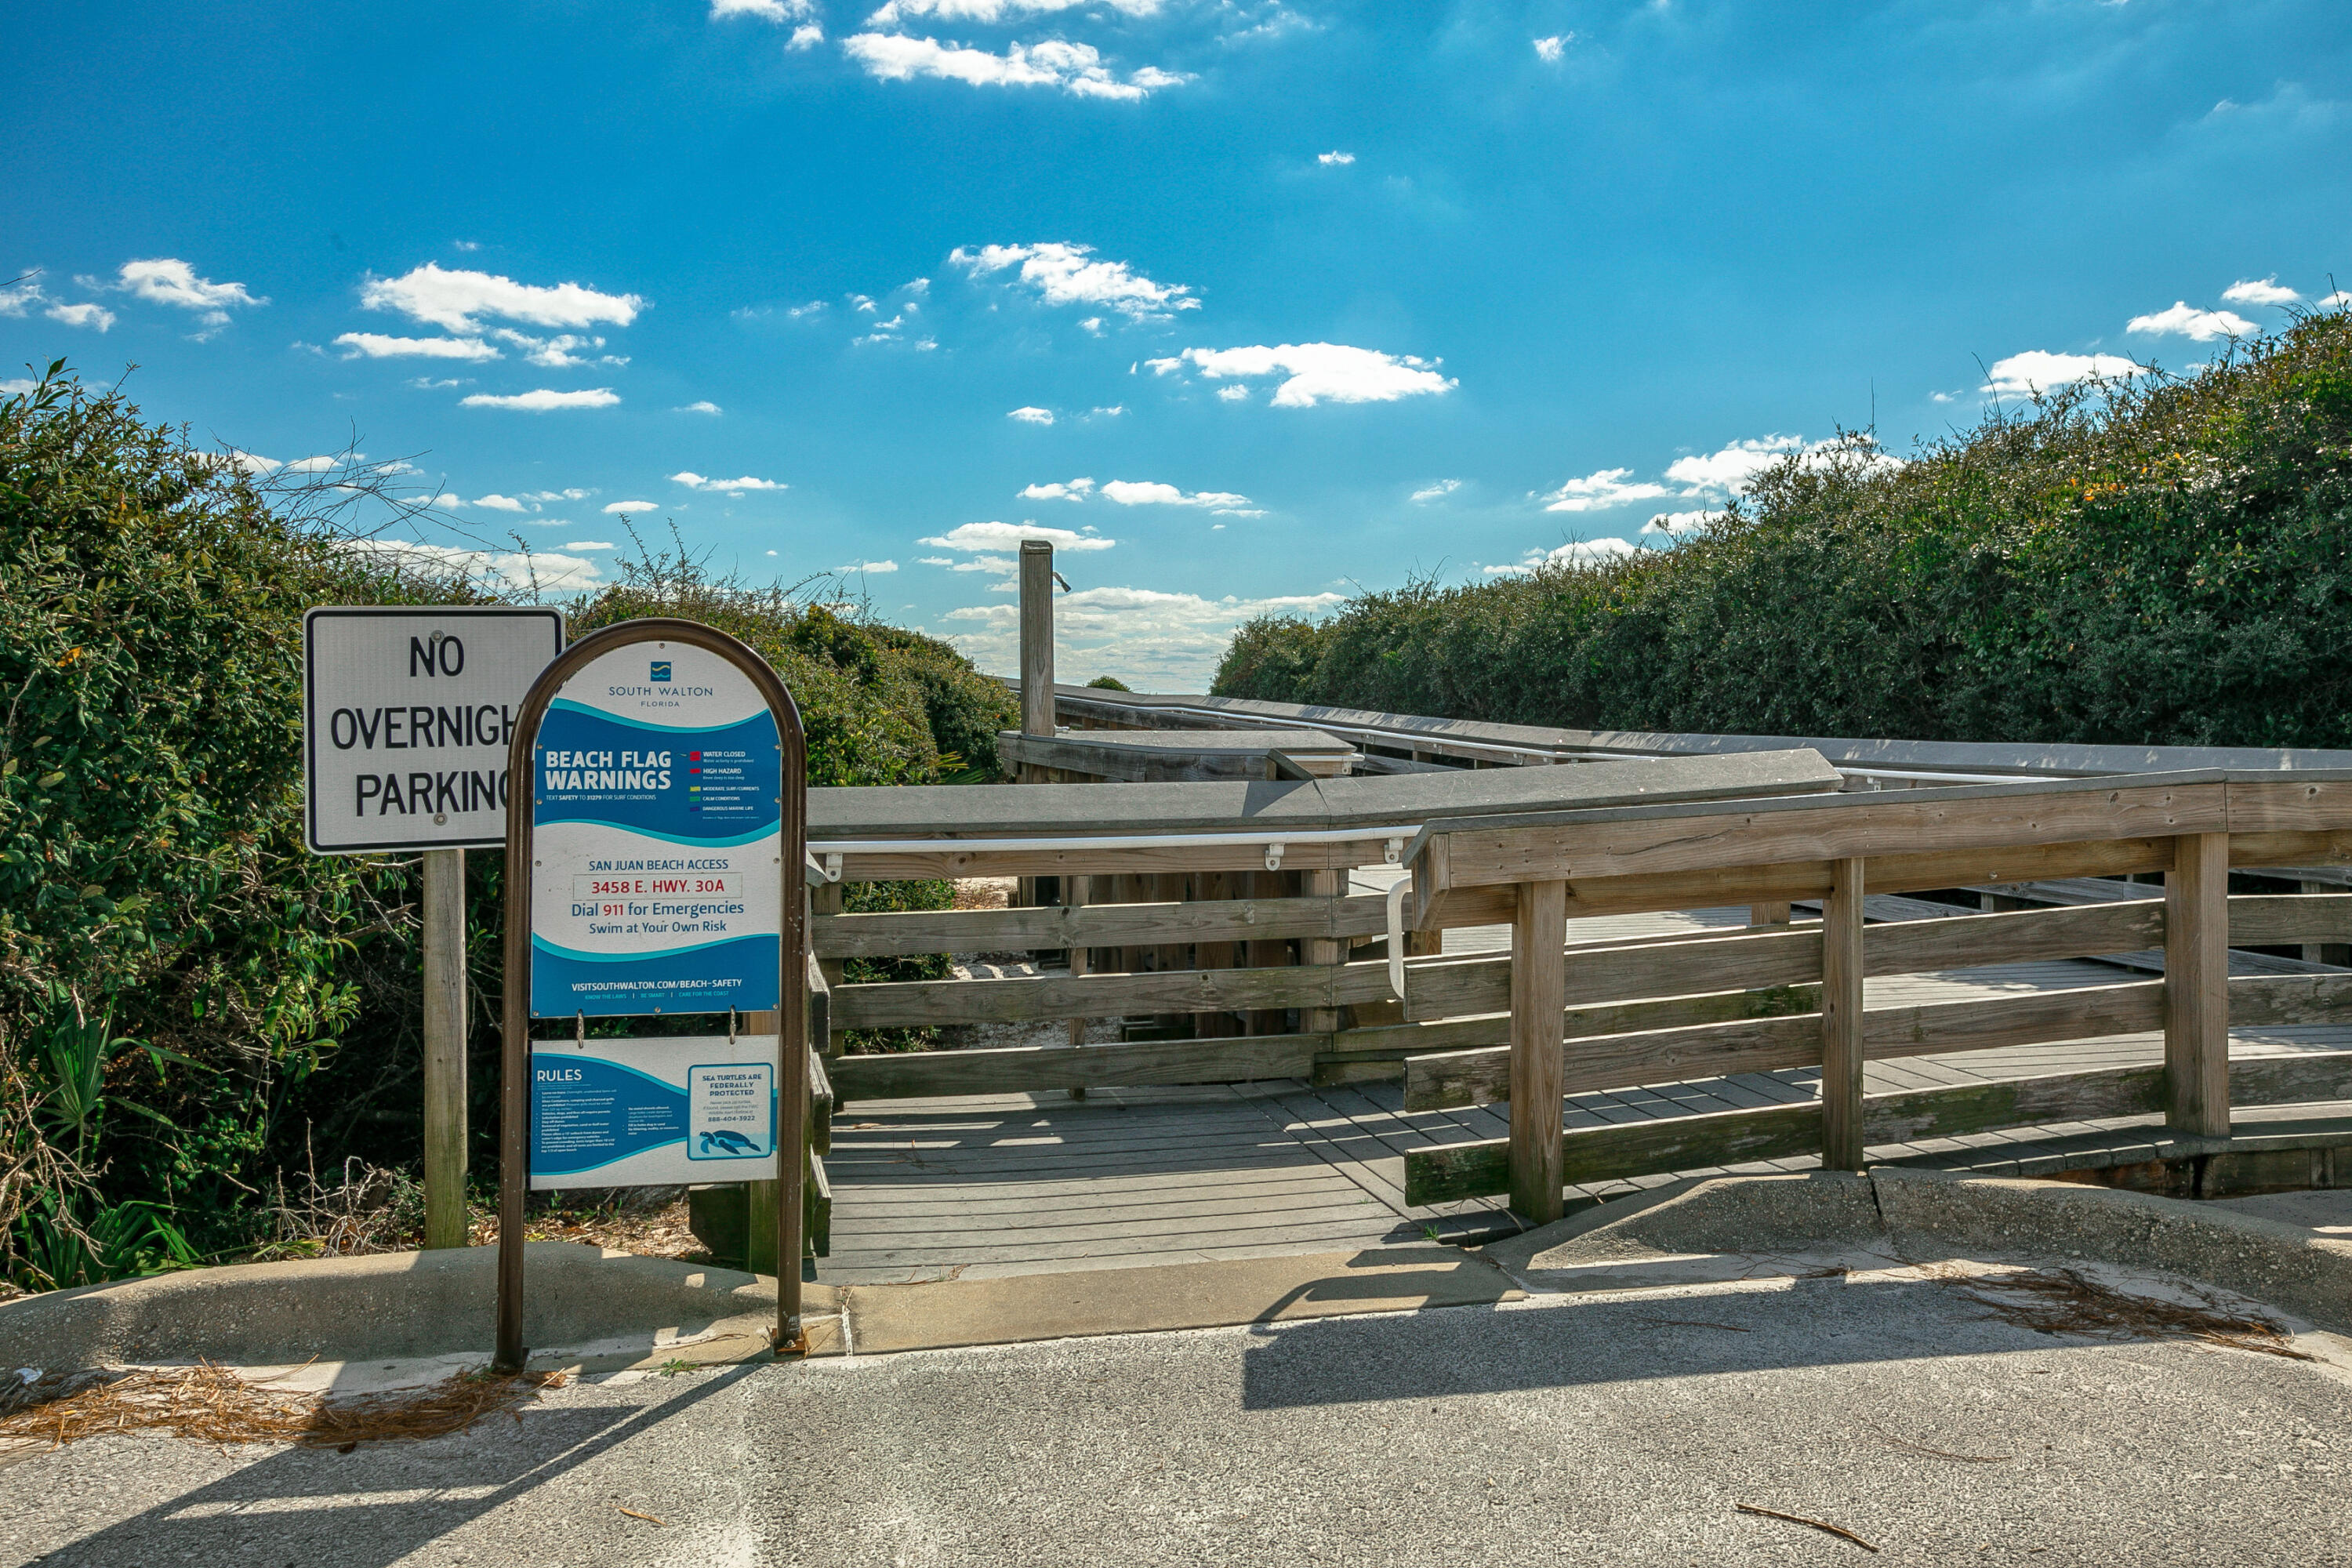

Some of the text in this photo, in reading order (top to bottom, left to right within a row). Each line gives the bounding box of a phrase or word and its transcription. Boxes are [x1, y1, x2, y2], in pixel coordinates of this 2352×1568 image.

[409, 636, 464, 677] NO
[608, 686, 713, 696] SOUTH WALTON
[331, 705, 516, 750] OVERNIGH
[546, 751, 672, 768] BEACH FLAG
[545, 770, 672, 790] WARNINGS
[589, 859, 729, 871] SAN JUAN BEACH ACCESS
[591, 879, 725, 894] 3458 E. HWY. 30A
[572, 901, 744, 918] Dial 911 for Emergencies
[589, 920, 727, 934] Swim at Your Own Risk
[572, 979, 742, 992] VISITSOUTHWALTON.COM/BEACH-SAFETY
[537, 1069, 583, 1082] RULES
